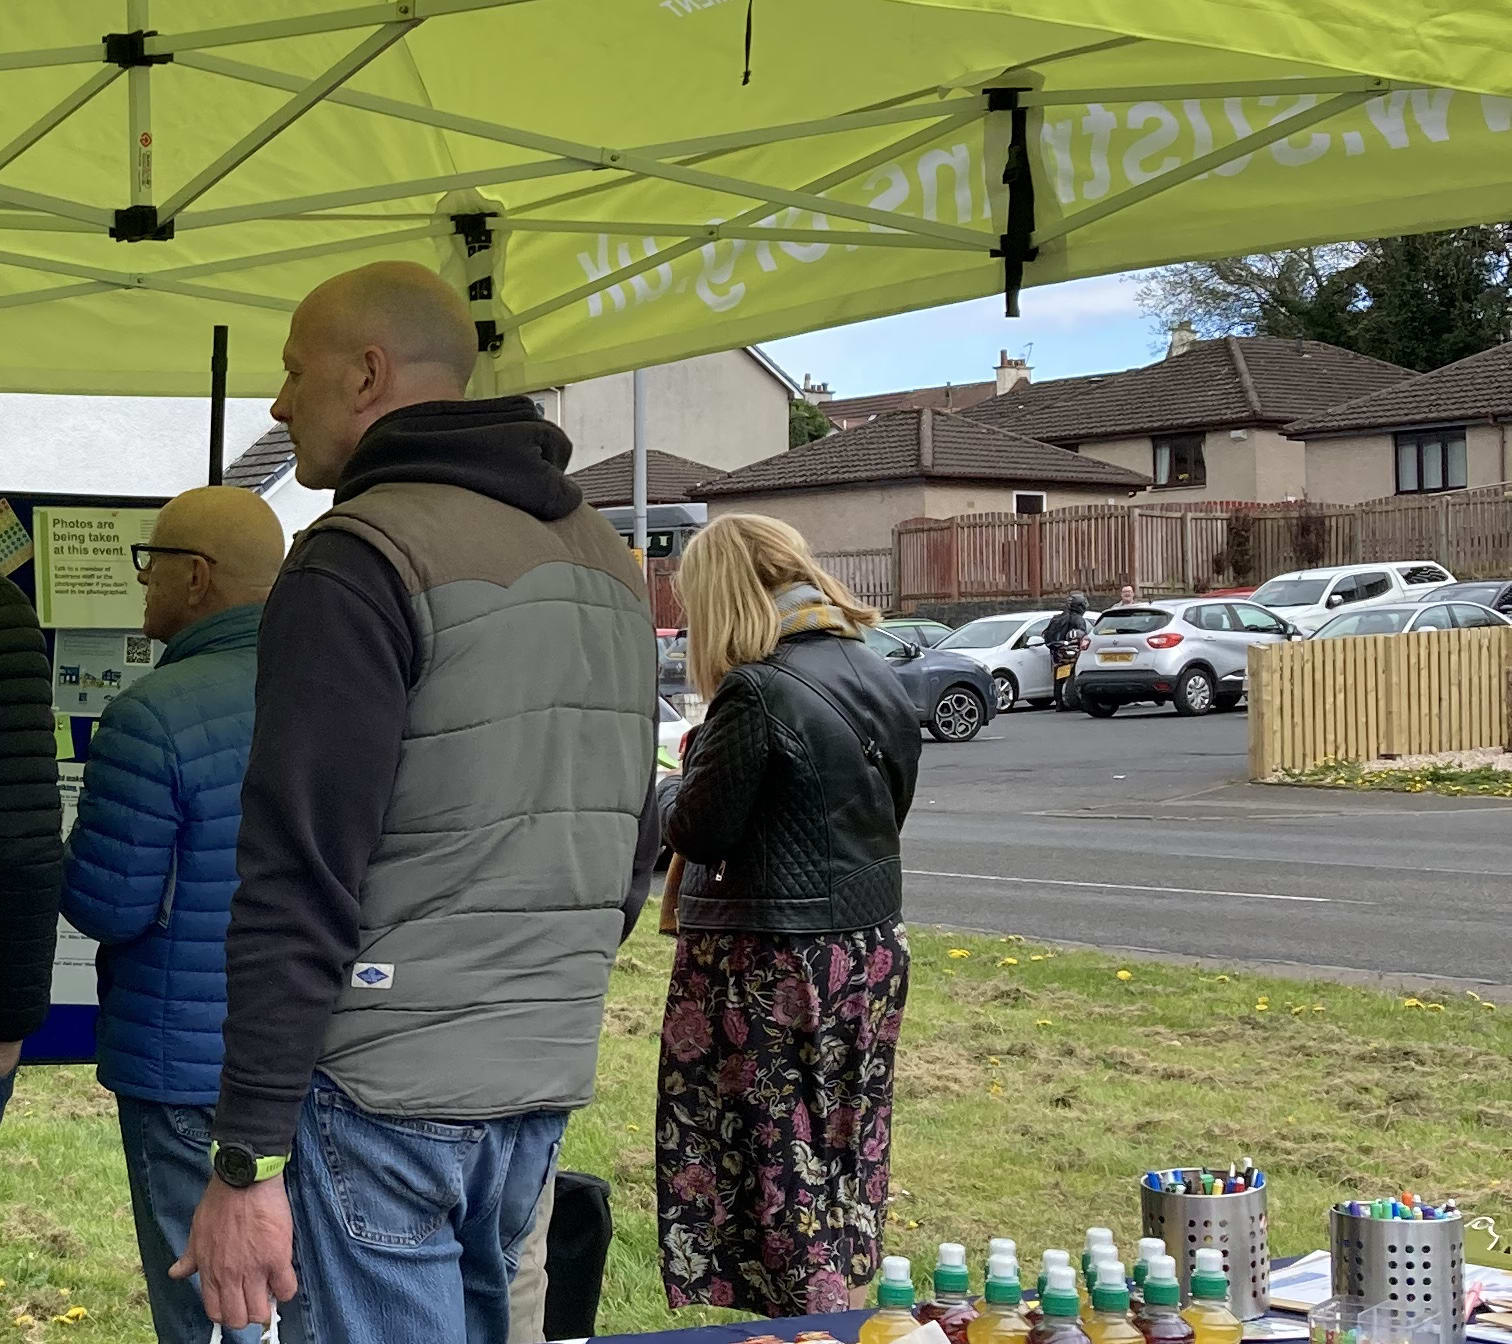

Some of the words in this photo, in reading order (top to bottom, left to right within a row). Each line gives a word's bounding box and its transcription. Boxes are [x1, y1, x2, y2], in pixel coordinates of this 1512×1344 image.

[52, 518, 93, 529] Photos
[96, 520, 115, 529] are
[53, 531, 85, 544] being
[88, 532, 119, 543] taken
[54, 546, 64, 555] at
[68, 545, 89, 555] this
[92, 547, 127, 556] event.
